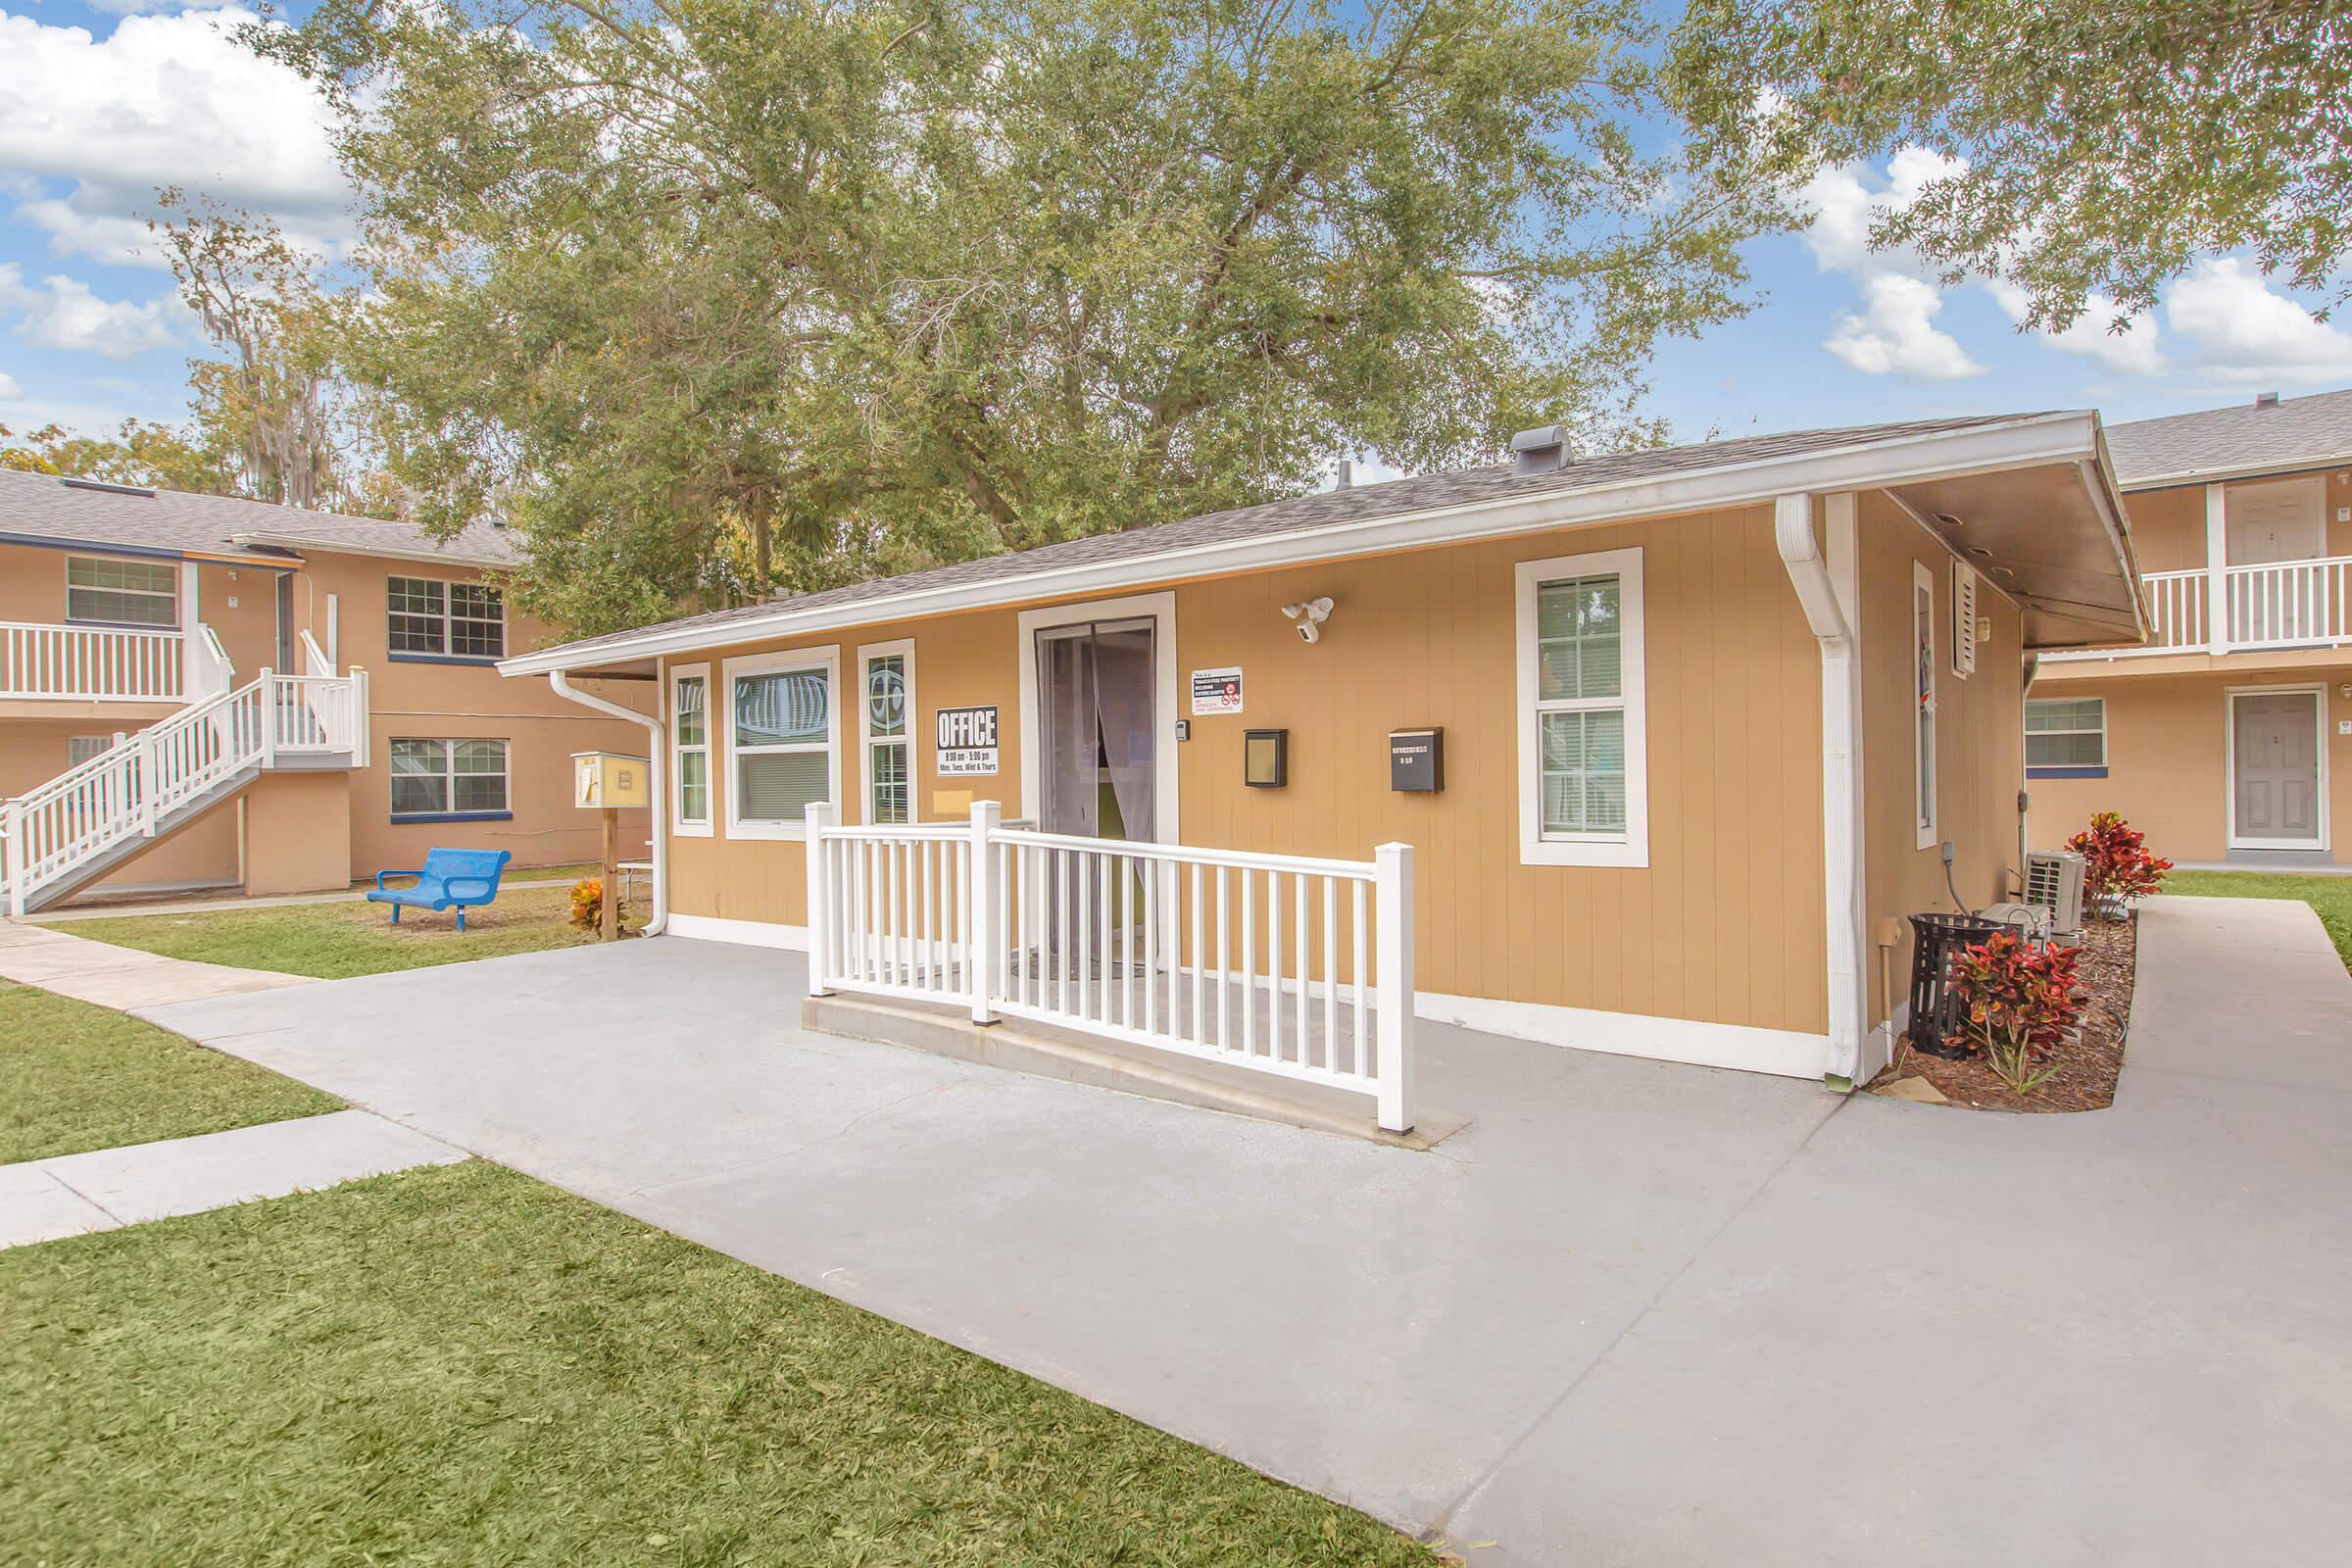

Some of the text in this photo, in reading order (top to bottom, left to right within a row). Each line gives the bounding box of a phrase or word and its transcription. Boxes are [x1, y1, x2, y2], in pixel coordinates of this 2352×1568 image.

[938, 710, 996, 748] OFFICE
[969, 751, 981, 761] 5:00
[982, 752, 989, 761] pm
